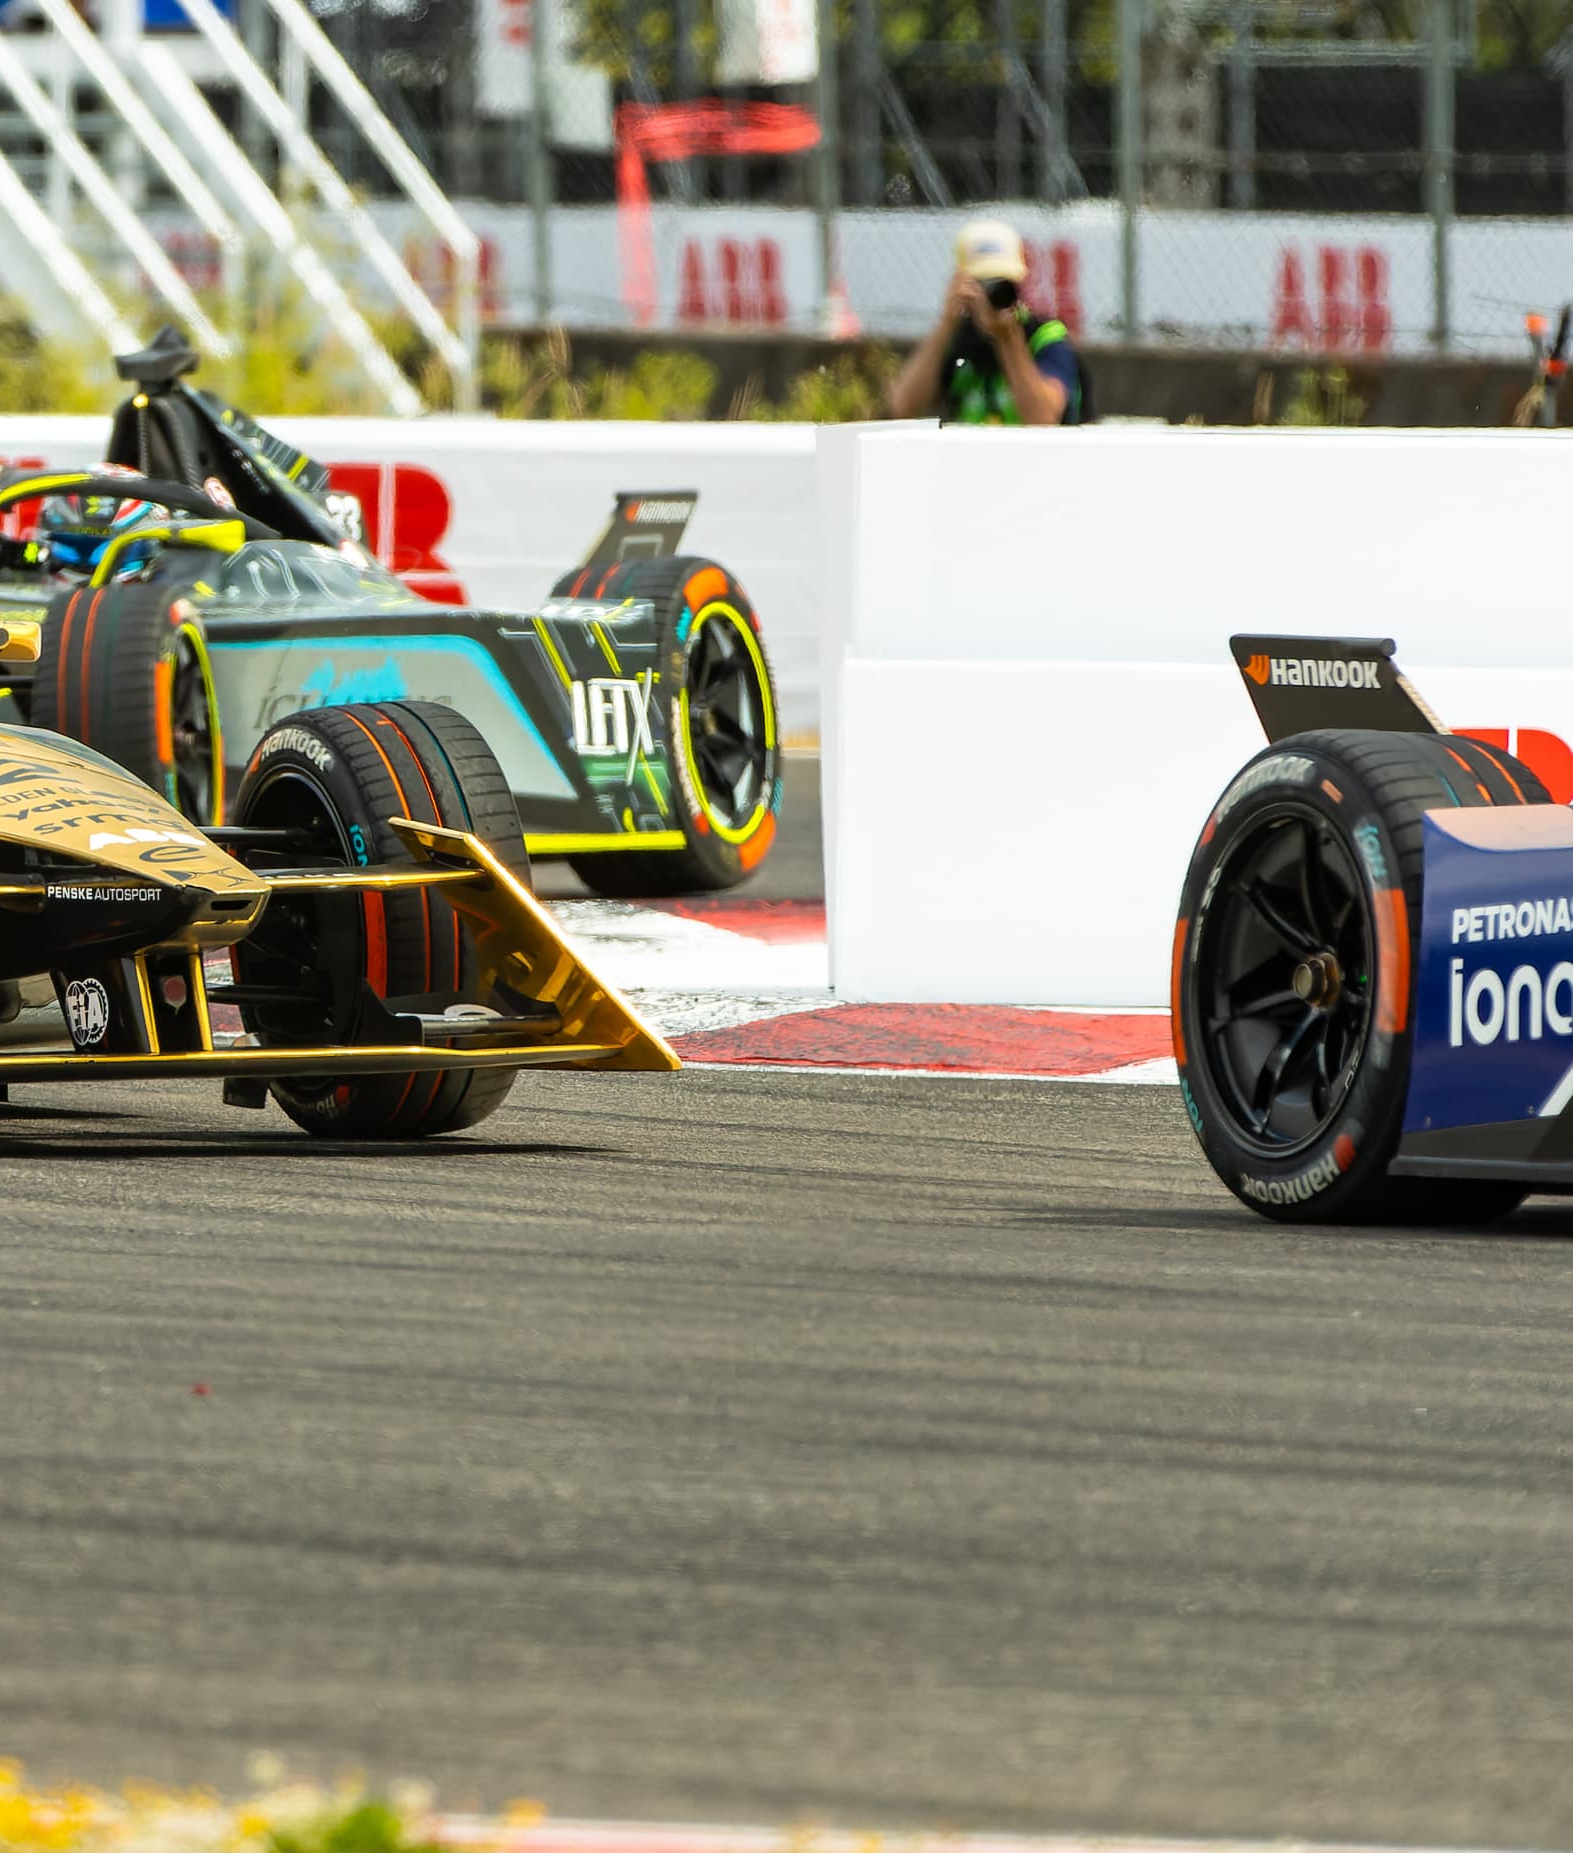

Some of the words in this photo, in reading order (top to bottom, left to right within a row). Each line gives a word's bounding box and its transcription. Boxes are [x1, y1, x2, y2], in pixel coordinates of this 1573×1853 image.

[47, 886, 93, 901] PENSKE
[94, 888, 162, 902] AUTOSPORT
[1452, 898, 1573, 943] PETRONA
